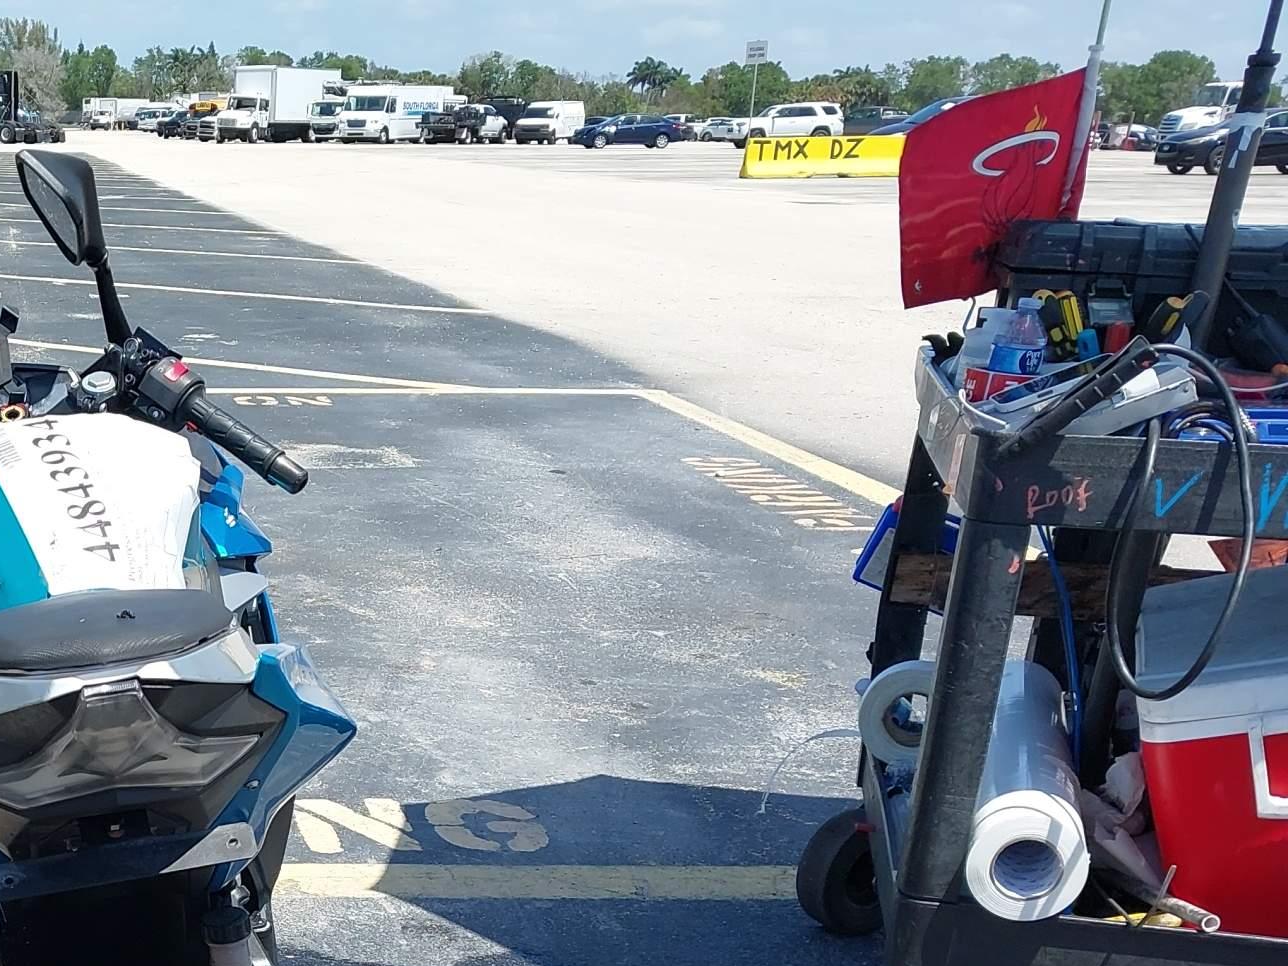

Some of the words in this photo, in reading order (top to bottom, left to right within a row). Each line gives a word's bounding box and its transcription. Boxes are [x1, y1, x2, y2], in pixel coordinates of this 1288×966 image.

[402, 101, 420, 110] SOUTH
[420, 101, 439, 110] FLORIDA
[753, 139, 810, 161] TMX
[830, 138, 865, 159] DZ
[23, 419, 121, 562] 44843934
